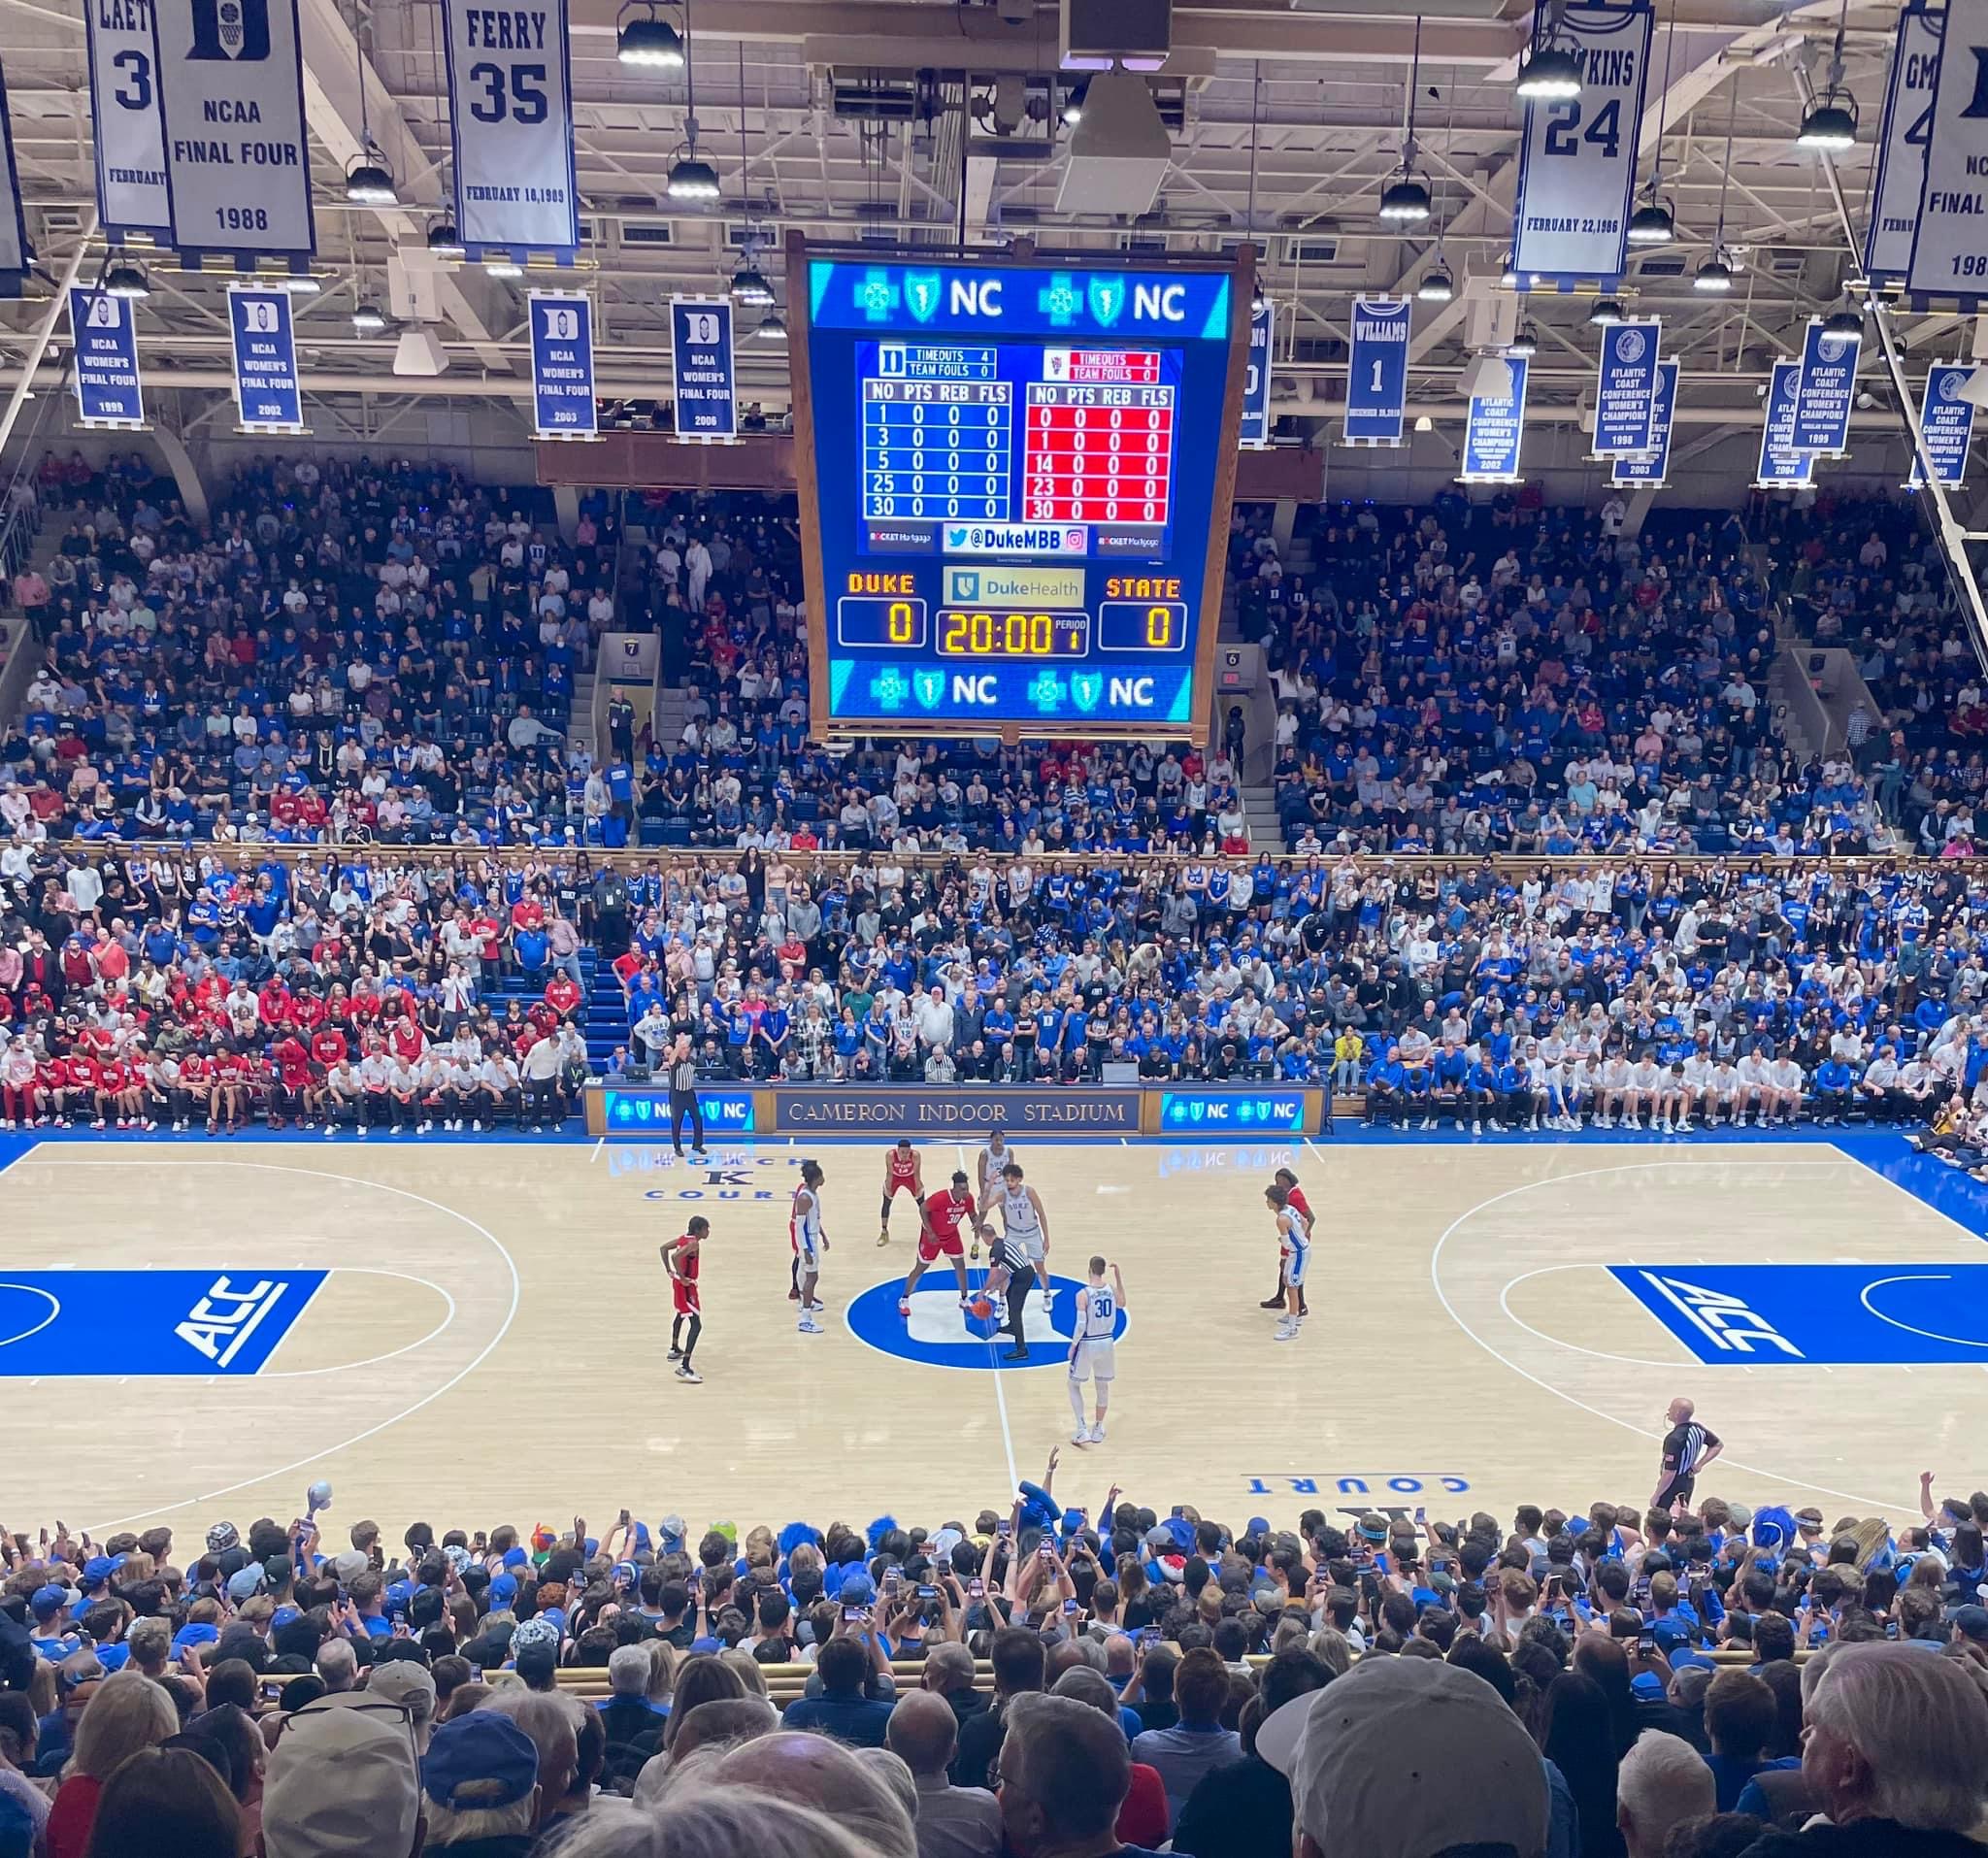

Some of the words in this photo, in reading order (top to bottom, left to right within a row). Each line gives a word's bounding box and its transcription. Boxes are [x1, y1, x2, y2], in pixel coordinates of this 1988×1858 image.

[467, 10, 546, 49] FERRY
[114, 50, 151, 110] 3
[470, 62, 547, 124] 35
[204, 101, 260, 123] NCAA
[1544, 99, 1621, 157] 24
[175, 141, 234, 163] FINAL
[241, 143, 298, 165] FOUR
[467, 185, 519, 201] FEBRUARY
[1929, 192, 1983, 214] FINAL
[215, 208, 268, 230] 1988
[1527, 217, 1580, 234] FEBRUARY
[1582, 218, 1618, 235] 22,1986
[949, 281, 1003, 316] NC
[1134, 284, 1186, 321] NC
[1356, 321, 1407, 342] WILLIAMS
[91, 339, 117, 350] NCAA
[251, 344, 276, 355] NCAA
[84, 356, 129, 368] WOMEN'S
[550, 351, 575, 361] NCAA
[691, 355, 715, 366] NCAA
[916, 349, 964, 361] TIMEOUTS
[981, 351, 988, 362] 4
[1079, 353, 1126, 366] TIMEOUTS
[1144, 355, 1151, 366] 4
[245, 361, 286, 373] WOMEN'S
[543, 368, 583, 379] WOMEN'S
[911, 363, 937, 376] TEAM
[939, 364, 969, 377] FOULS
[981, 366, 988, 377] 0
[1075, 368, 1099, 380] TEAM
[1102, 369, 1132, 381] FOULS
[1143, 370, 1150, 381] 0
[1610, 368, 1646, 378] ATLANTIC
[1811, 368, 1845, 377] ATLANTIC
[82, 374, 108, 385] FINAL
[111, 375, 136, 386] FOUR
[683, 372, 725, 382] WOMEN'S
[1371, 360, 1383, 391] 1
[1815, 379, 1839, 387] COAST
[242, 378, 267, 388] FINAL
[270, 378, 293, 389] FOUR
[539, 384, 564, 396] FINAL
[566, 385, 590, 397] FOUR
[1615, 379, 1640, 388] COAST
[679, 389, 705, 399] FINAL
[707, 389, 730, 400] FOUR
[873, 383, 894, 399] NO
[904, 384, 933, 400] PTS
[940, 385, 969, 401] REB
[979, 386, 1007, 402] FLS
[1036, 387, 1057, 403] NO
[1068, 388, 1095, 404] PTS
[1103, 389, 1131, 405] REB
[1142, 389, 1168, 406] FLS
[1602, 389, 1650, 399] CONFERENCE
[1802, 389, 1849, 398] CONFERENCE
[99, 402, 123, 413] 1999
[259, 405, 282, 416] 2002
[1607, 401, 1643, 410] WOMEN'S
[1806, 400, 1840, 409] WOMEN'S
[1933, 406, 1965, 415] ATLANTIC
[879, 404, 886, 423] 1
[912, 405, 924, 424] 0
[948, 406, 960, 425] 0
[987, 407, 999, 426] 0
[1041, 408, 1051, 427] 0
[1075, 409, 1086, 428] 0
[1110, 409, 1121, 429] 0
[1148, 411, 1160, 430] 0
[1602, 412, 1646, 420] CHAMPIONS
[1801, 411, 1843, 419] CHAMPIONS
[878, 427, 889, 447] 3
[912, 428, 924, 448] 0
[948, 429, 959, 448] 0
[986, 430, 998, 448] 0
[1923, 426, 1968, 435] CONFERENCE
[1042, 431, 1048, 450] 1
[1074, 432, 1085, 451] 0
[1110, 433, 1120, 452] 0
[1147, 433, 1158, 452] 0
[1927, 436, 1961, 445] WOMEN'S
[878, 450, 889, 470] 5
[912, 451, 923, 470] 0
[948, 452, 959, 471] 0
[986, 452, 998, 472] 0
[1036, 454, 1053, 473] 14
[1073, 454, 1084, 474] 0
[1108, 455, 1119, 475] 0
[1145, 456, 1157, 476] 0
[874, 474, 894, 493] 25
[912, 475, 923, 493] 0
[947, 476, 959, 494] 0
[986, 476, 997, 495] 0
[1034, 478, 1054, 496] 23
[1072, 479, 1083, 497] 0
[1108, 479, 1118, 498] 0
[1144, 480, 1156, 499] 0
[874, 497, 894, 515] 30
[912, 497, 923, 516] 0
[947, 498, 959, 517] 0
[985, 499, 996, 517] 0
[1032, 500, 1053, 519] 30
[1072, 501, 1082, 520] 0
[1107, 501, 1117, 520] 0
[1143, 502, 1155, 521] 0
[971, 528, 1061, 549] @DukeMBB
[848, 574, 914, 594] DUKE
[987, 581, 1078, 597] DukeHealth
[1107, 579, 1180, 598] STATE
[889, 603, 912, 643] 0
[1056, 620, 1086, 631] PERIOD
[1147, 608, 1171, 647] 0
[945, 614, 1052, 653] 20:00
[1071, 632, 1077, 649] 1
[628, 645, 635, 653] 7
[1230, 654, 1237, 664] 6
[952, 676, 997, 704] NC
[1110, 678, 1154, 706] NC
[723, 1103, 746, 1117] NC
[789, 1104, 904, 1121] CAMERON
[918, 1104, 1008, 1121] INDOOR
[1024, 1104, 1125, 1122] STADIUM
[1208, 1104, 1228, 1117] NC
[1274, 1104, 1295, 1117] NC
[702, 1172, 753, 1185] K
[947, 1213, 961, 1224] 30
[1018, 1211, 1023, 1219] 1
[1095, 1299, 1111, 1318] 30
[174, 1275, 274, 1360] ACC
[1661, 1277, 1806, 1358] ACC
[1247, 1477, 1471, 1494] COURT
